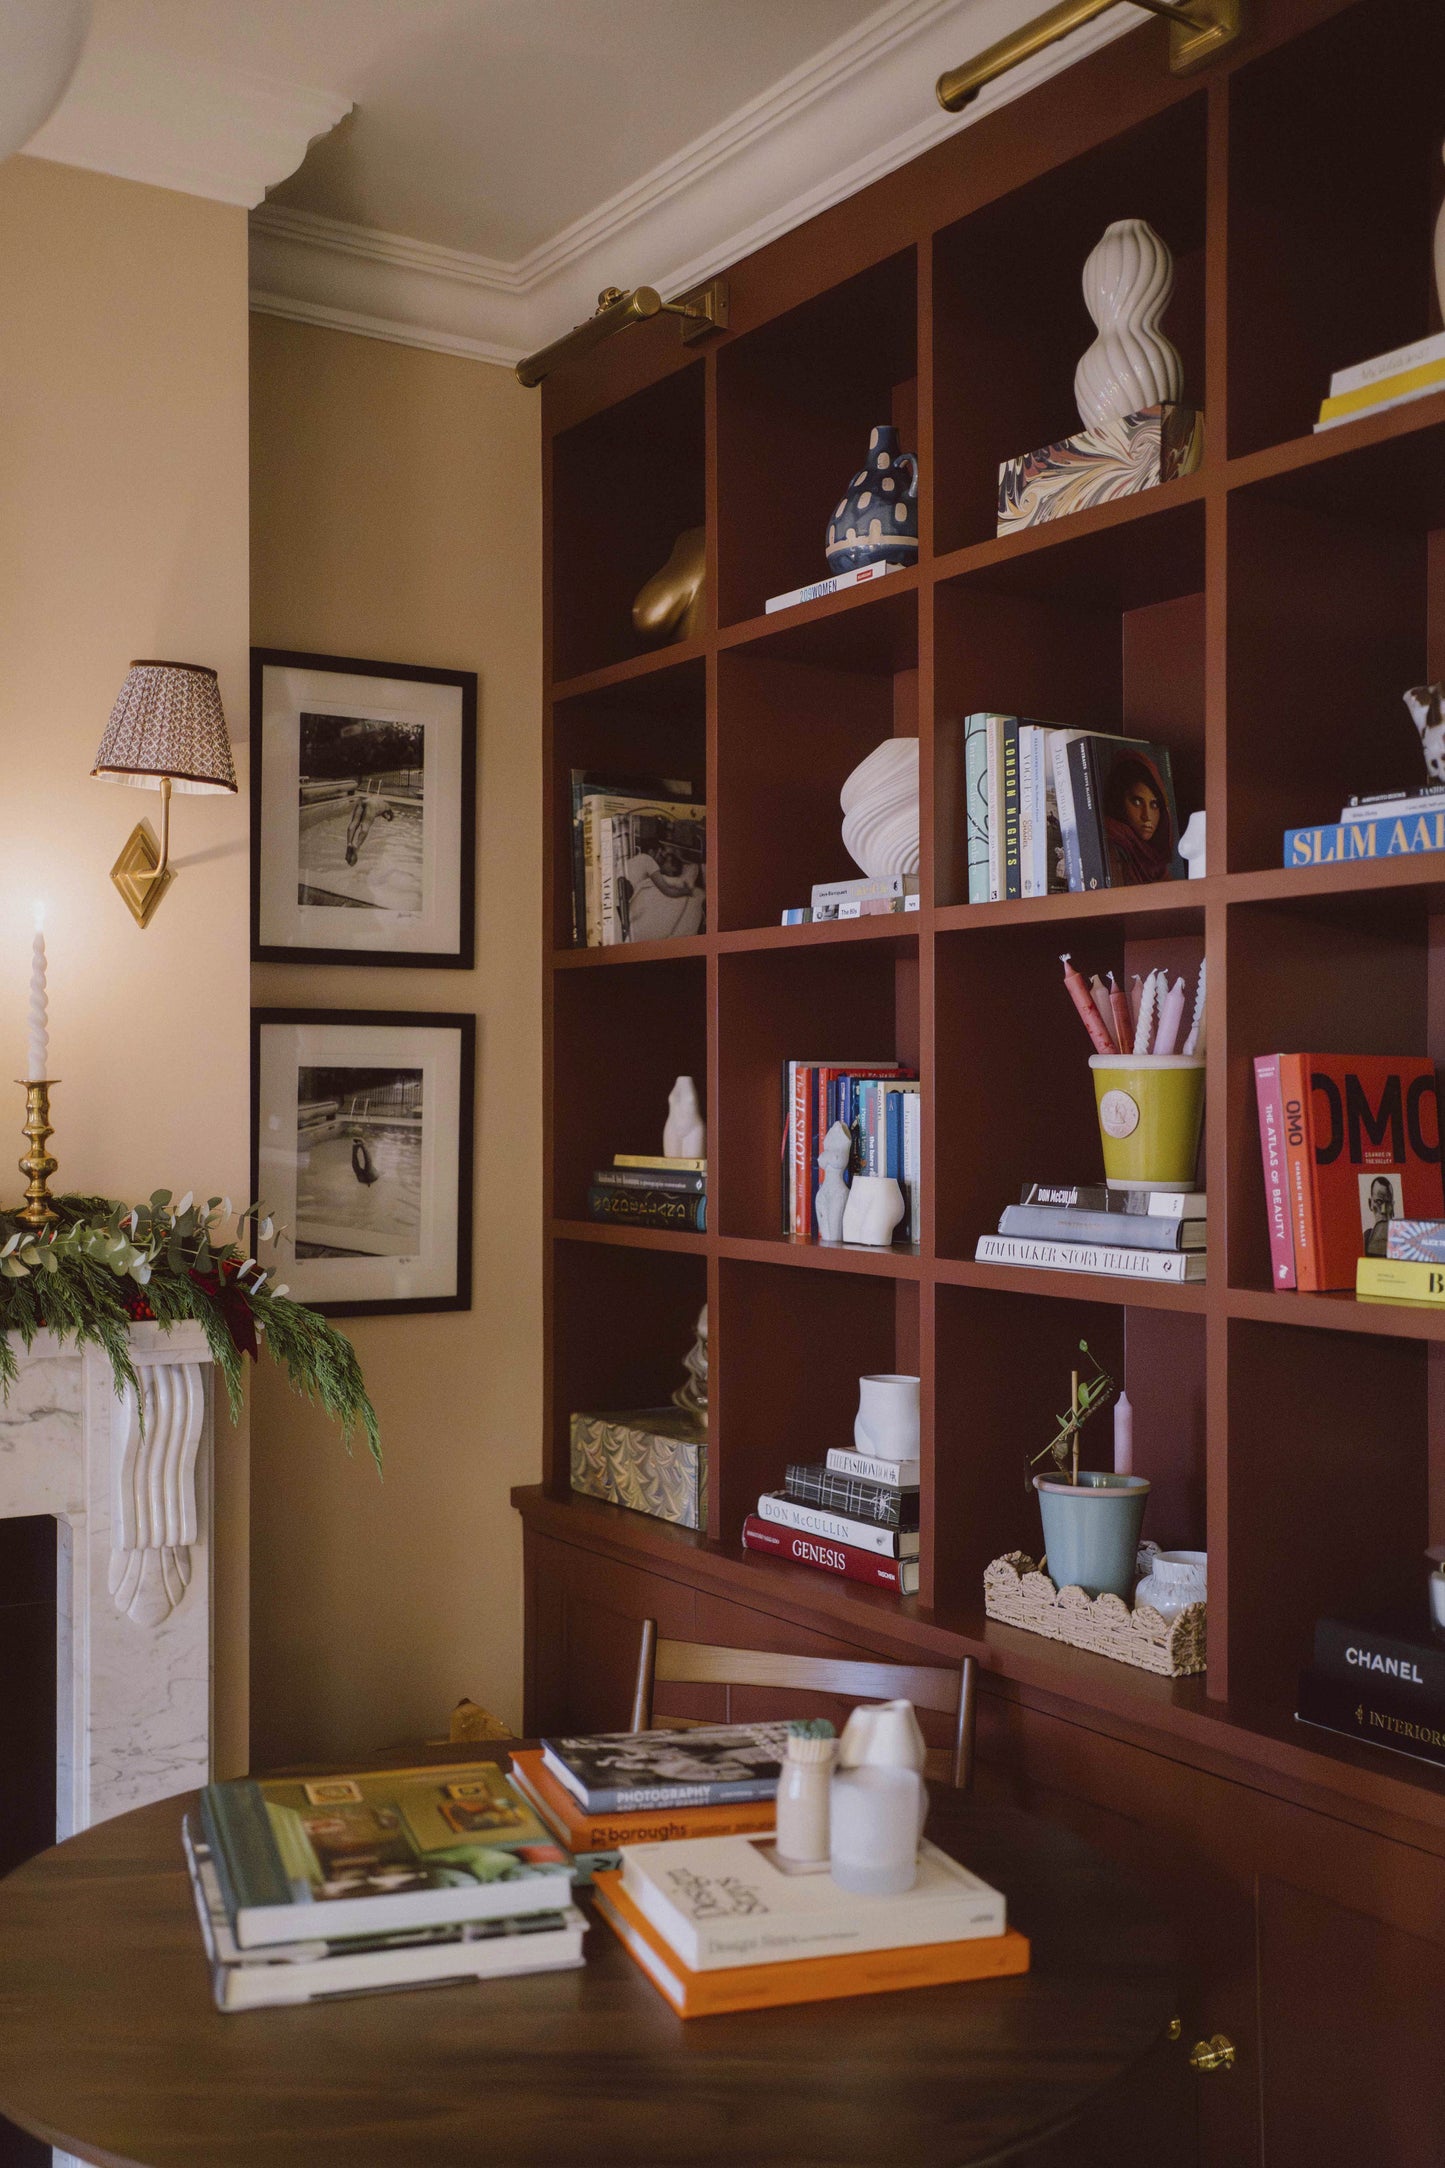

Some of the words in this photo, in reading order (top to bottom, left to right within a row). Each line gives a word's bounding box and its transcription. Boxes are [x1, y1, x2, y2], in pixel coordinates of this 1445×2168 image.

[1005, 738, 1016, 798] LONDON
[1024, 753, 1032, 792] VOGUE
[1054, 746, 1062, 776] Julia
[1056, 780, 1070, 825] Samuel
[1006, 807, 1017, 866] NIGHTS
[1292, 823, 1377, 865] SLIM
[1266, 1104, 1274, 1124] THE
[1286, 1100, 1303, 1147] OMO
[1310, 1072, 1440, 1165] OMO
[1267, 1127, 1279, 1167] ATLAS
[1270, 1169, 1278, 1184] OF
[1294, 1161, 1302, 1191] CHANGE
[1038, 1188, 1050, 1202] DON
[1297, 1192, 1302, 1201] IN
[1272, 1188, 1285, 1240] BEAUTY
[984, 1240, 1004, 1256] TIM
[1005, 1242, 1056, 1262] WALKER
[1060, 1248, 1098, 1266] STORY
[1102, 1253, 1150, 1272] TELLER
[829, 1452, 844, 1470] THE
[843, 1456, 876, 1479] FASHION
[765, 1504, 788, 1521] DON
[792, 1511, 850, 1538] McCULLIN
[792, 1539, 846, 1570] GENESIS
[1346, 1647, 1424, 1684] CHANEL
[616, 1784, 712, 1804] PHOTOGRAPHY
[608, 1822, 687, 1842] boroughs
